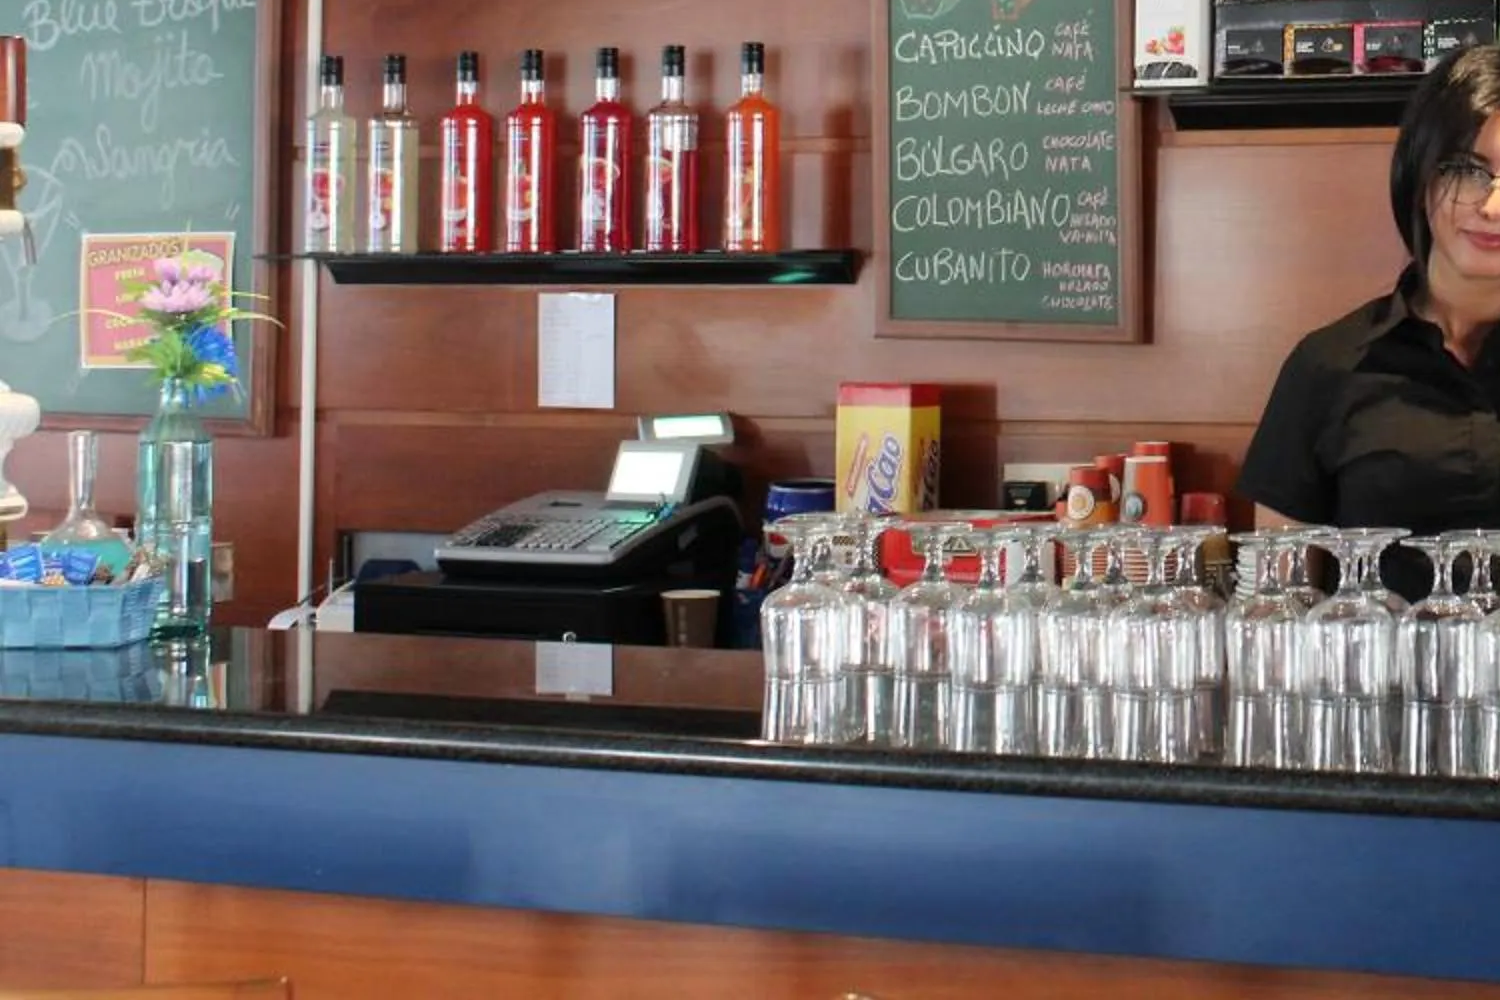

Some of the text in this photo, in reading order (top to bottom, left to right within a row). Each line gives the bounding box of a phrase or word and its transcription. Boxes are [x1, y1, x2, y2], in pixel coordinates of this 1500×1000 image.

[1052, 40, 1094, 62] NATA
[896, 80, 1031, 121] BOMBON
[1045, 155, 1092, 174] NATA
[88, 237, 181, 267] GRANIZADOS
[895, 247, 1031, 286] CUBANITO
